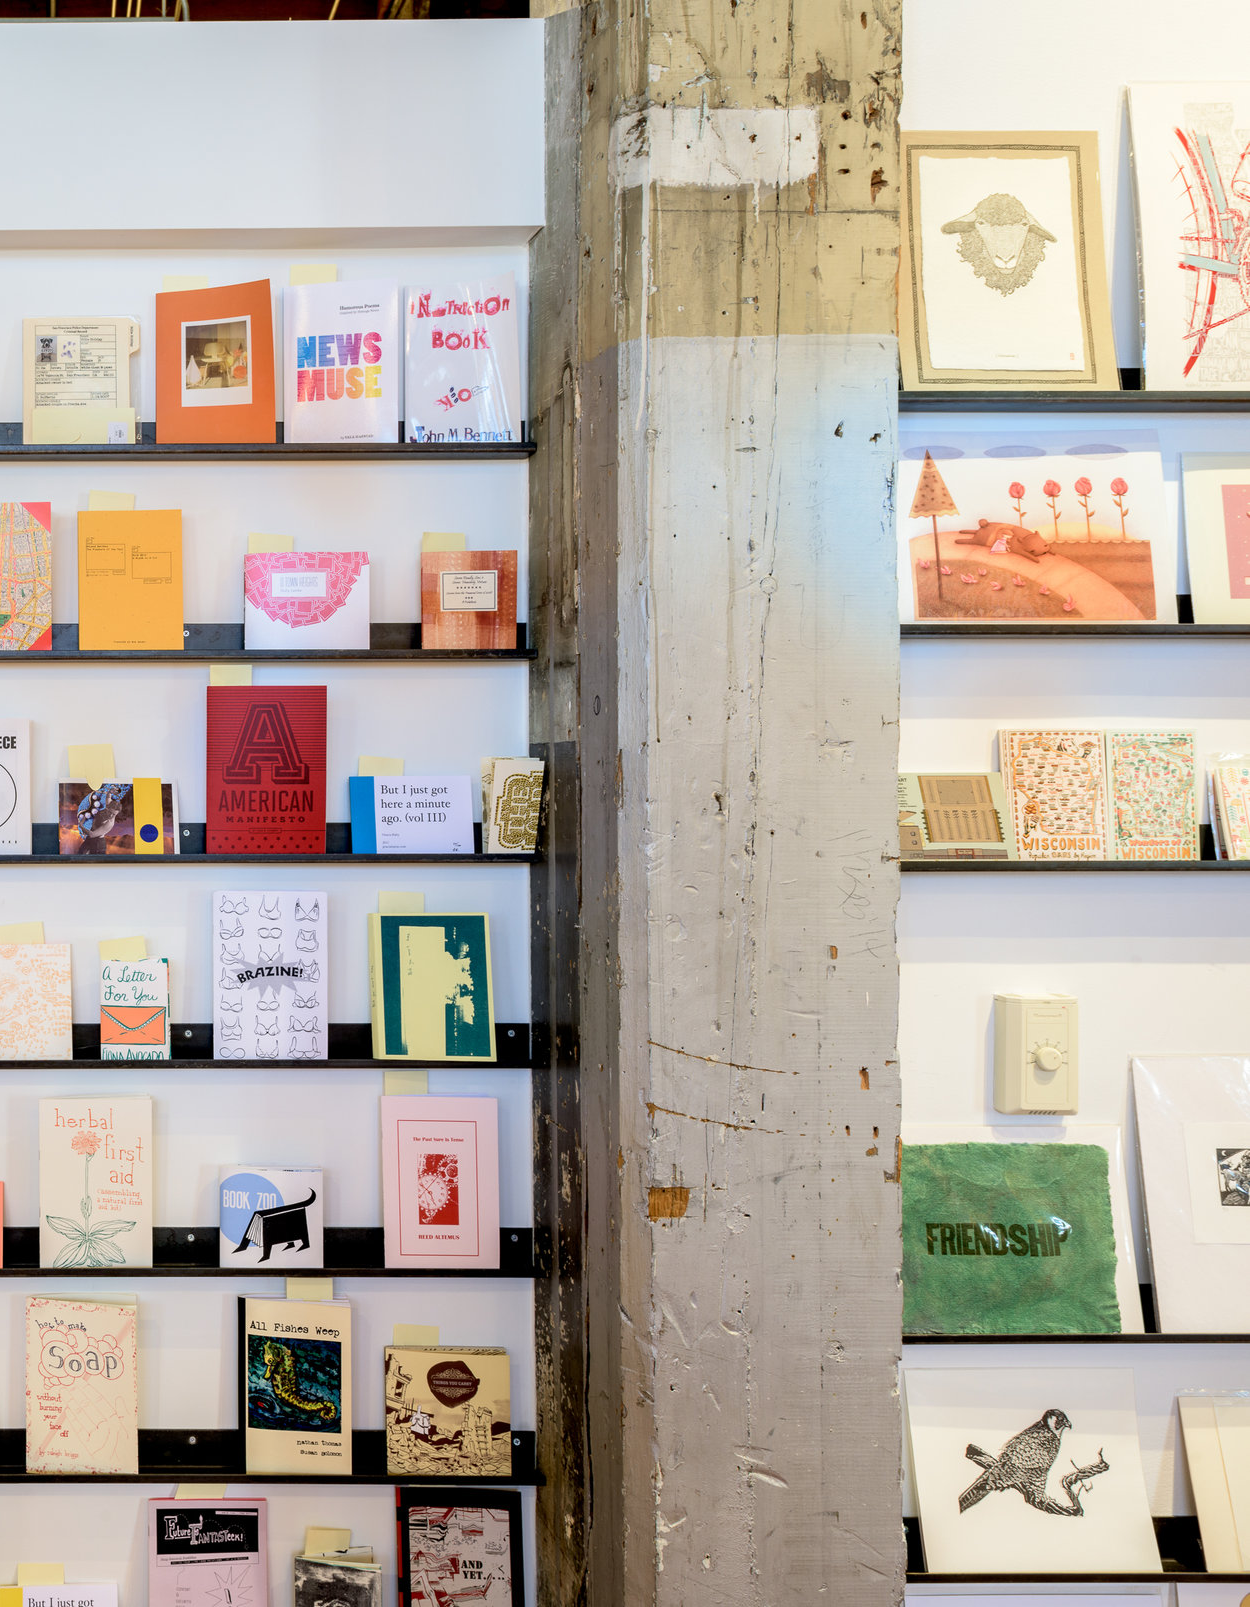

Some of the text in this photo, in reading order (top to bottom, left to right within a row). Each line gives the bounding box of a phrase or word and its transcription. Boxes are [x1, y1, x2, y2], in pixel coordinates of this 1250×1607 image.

[297, 332, 382, 368] NEWS
[297, 366, 382, 402] MUSE
[222, 700, 310, 785] A
[218, 790, 314, 812] AMERICAN
[380, 784, 448, 797] But I just got
[380, 799, 404, 809] here
[414, 799, 451, 809] minute
[381, 812, 447, 826] ago. (vol III)
[1021, 837, 1100, 851] WISCONSIN
[1120, 847, 1191, 859] WISCONSIN
[102, 965, 157, 983] A Letter
[236, 966, 304, 984] BRAZINE!
[104, 984, 159, 1006] For You
[54, 1107, 114, 1130] herbal
[103, 1133, 145, 1163] first
[109, 1162, 135, 1186] aid
[222, 1189, 277, 1210] BOOK ZOO
[925, 1222, 1069, 1257] FRIENDSHIP
[250, 1320, 341, 1338] All Fishes Weep
[48, 1345, 118, 1378] Soap
[461, 1560, 483, 1569] AND
[28, 1597, 45, 1607] But
[56, 1597, 75, 1607] just
